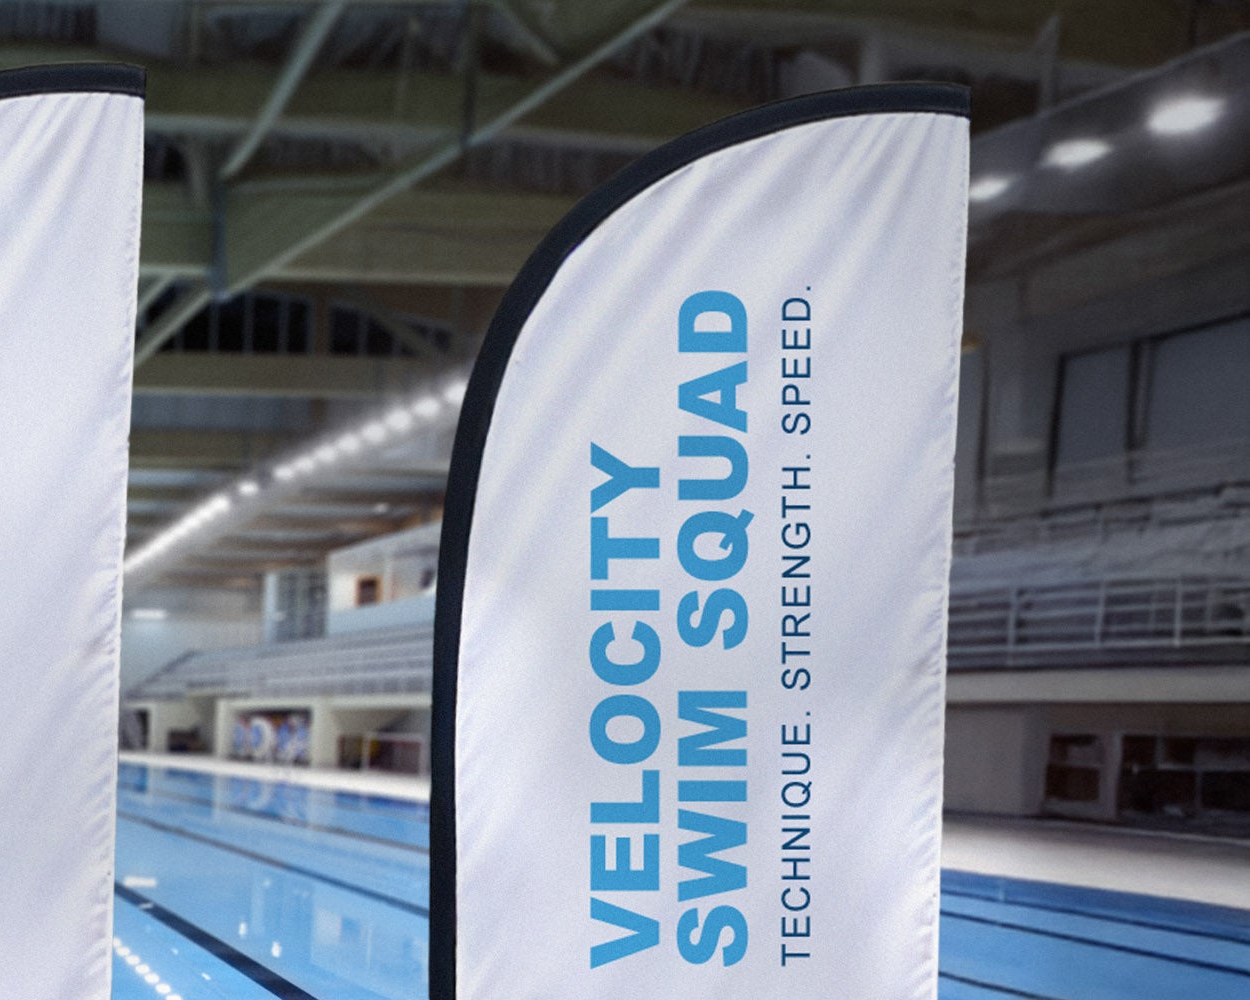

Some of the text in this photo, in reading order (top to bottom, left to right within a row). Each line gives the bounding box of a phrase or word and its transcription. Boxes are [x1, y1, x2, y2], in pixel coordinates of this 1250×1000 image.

[589, 442, 661, 970] VELOCITY
[676, 290, 754, 968] SWIM SQUAD
[781, 286, 812, 968] TECHNIQUE. STRENGTH. SPEED.
